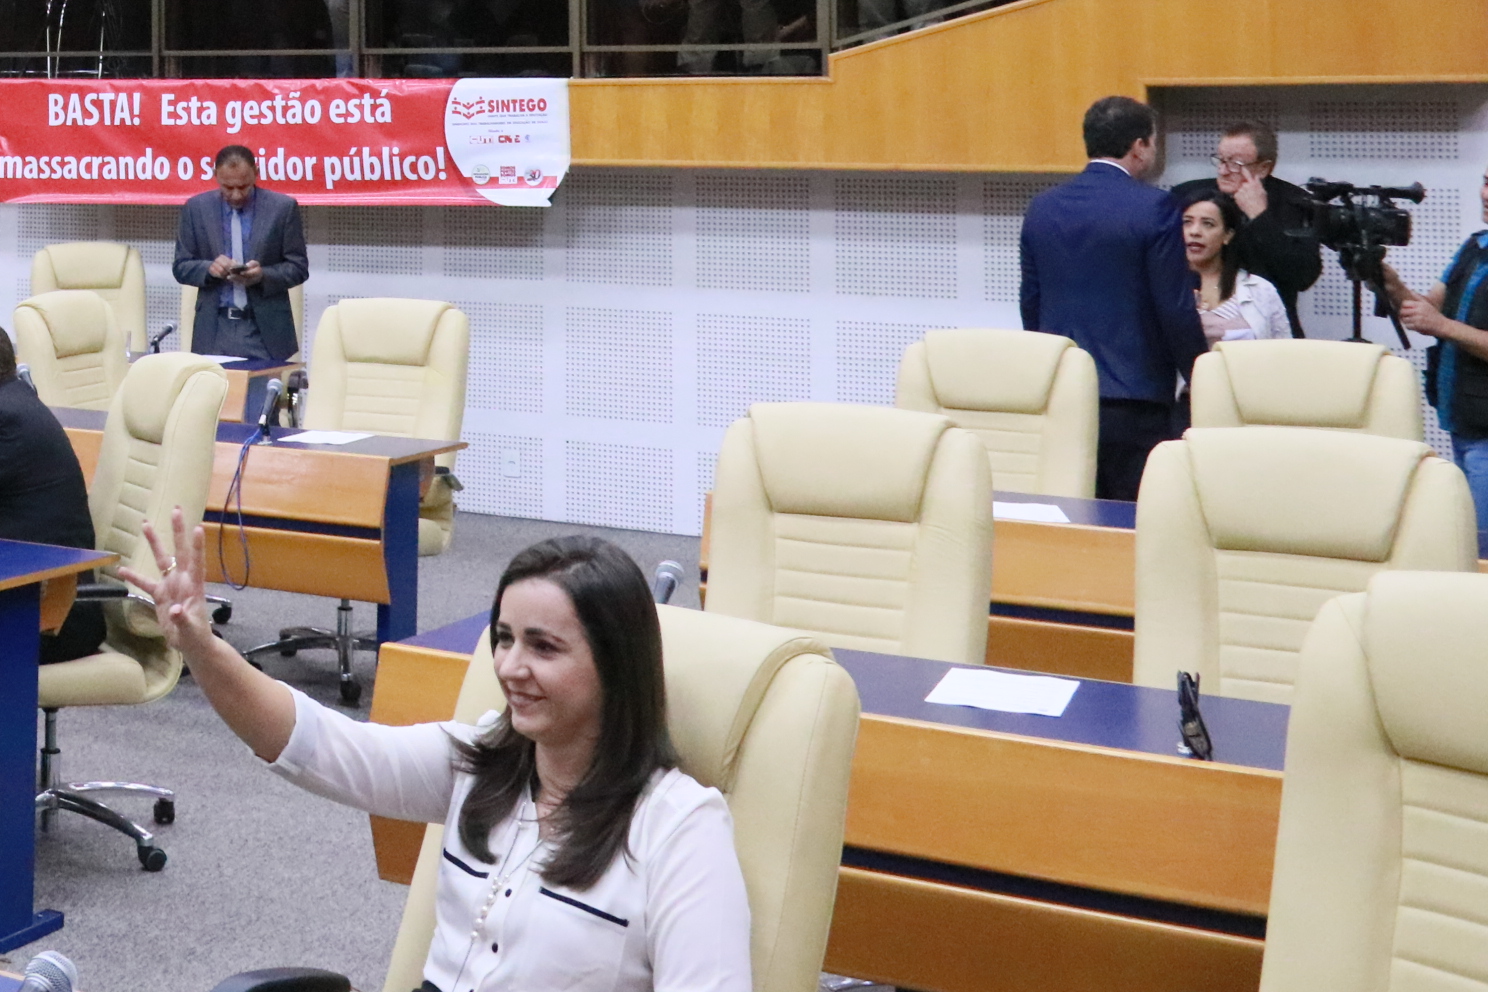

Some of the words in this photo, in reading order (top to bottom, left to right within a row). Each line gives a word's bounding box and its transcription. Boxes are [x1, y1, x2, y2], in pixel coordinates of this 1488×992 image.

[47, 92, 141, 126] BASTA!
[160, 93, 218, 126] Esta
[225, 91, 322, 134] gestão
[328, 89, 392, 124] está
[487, 97, 547, 113] SINTEGO
[177, 156, 194, 181] o
[200, 147, 317, 181] sidor
[323, 146, 447, 190] público!
